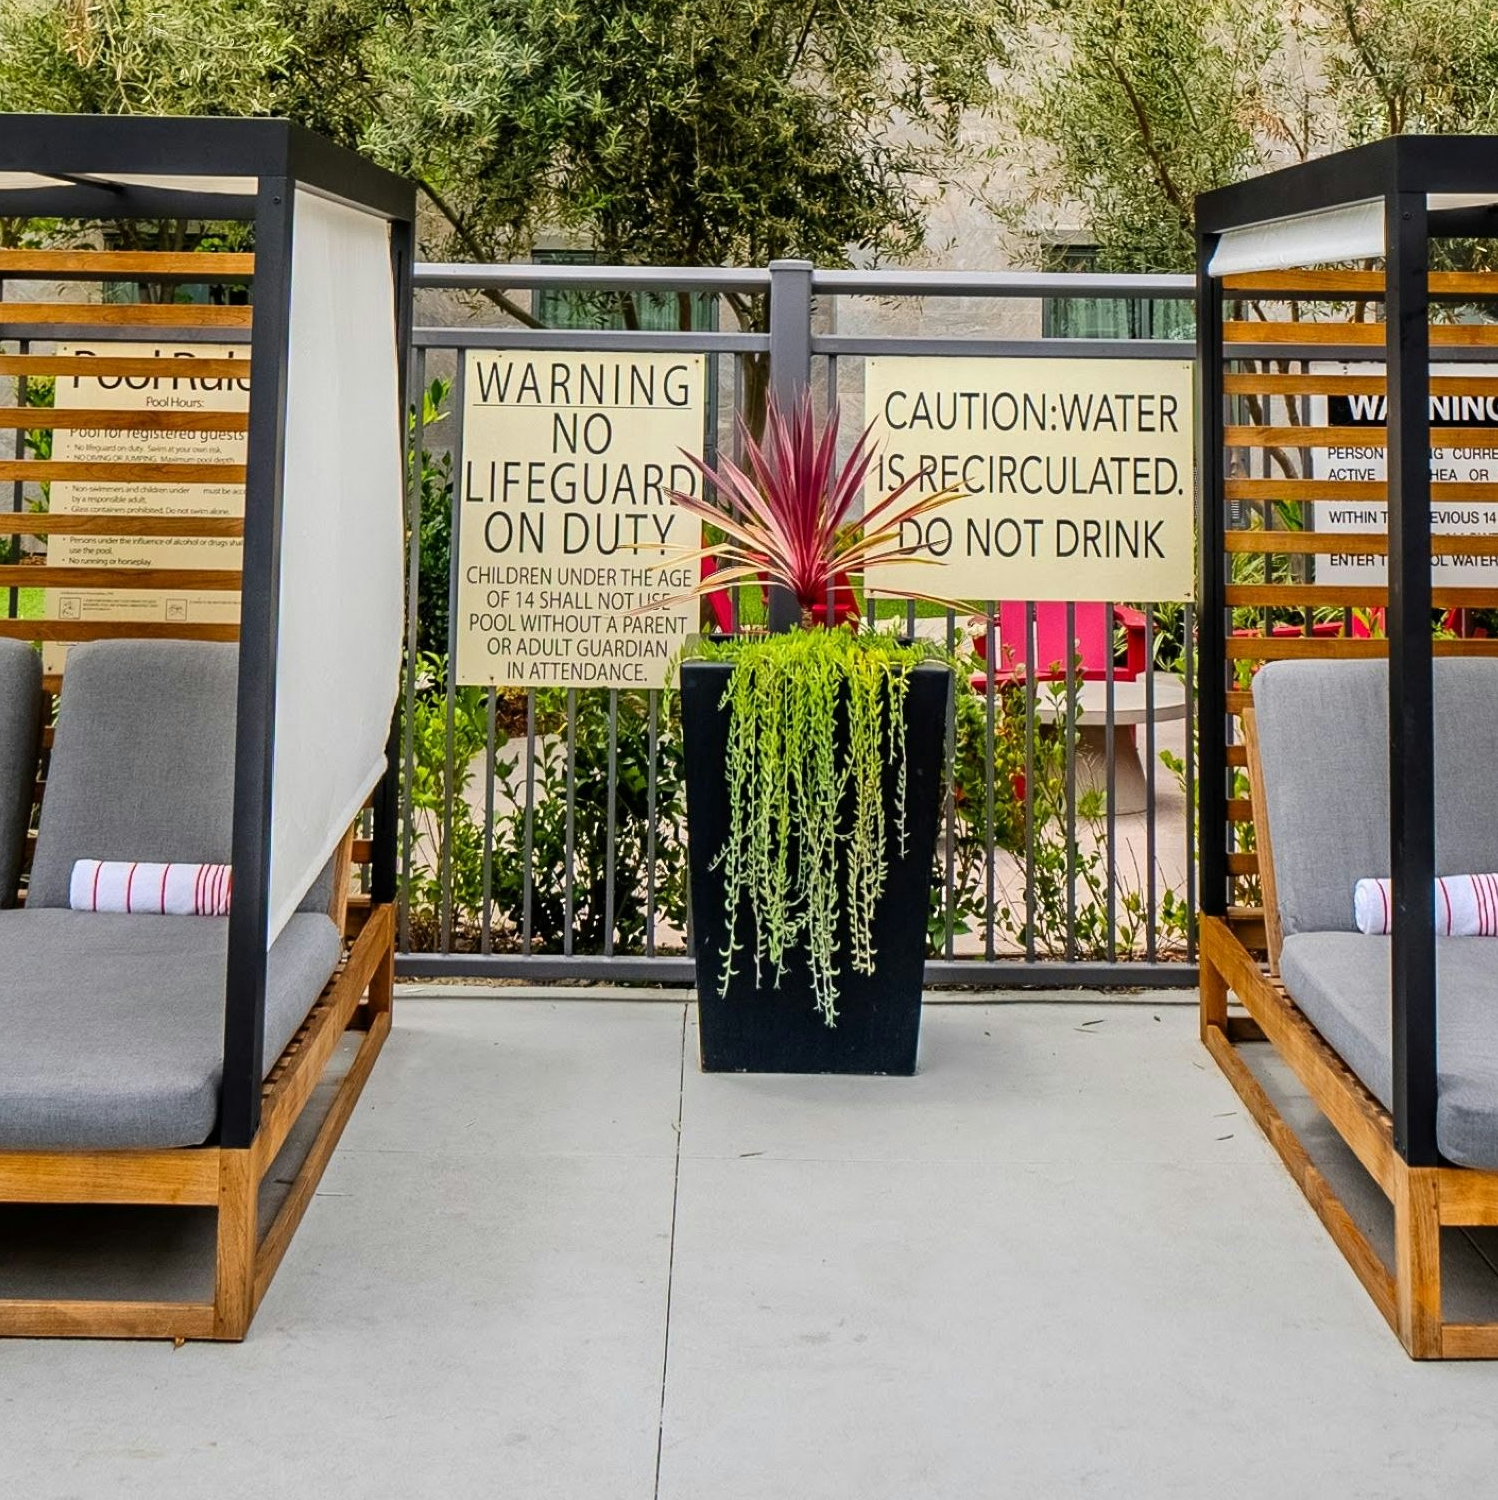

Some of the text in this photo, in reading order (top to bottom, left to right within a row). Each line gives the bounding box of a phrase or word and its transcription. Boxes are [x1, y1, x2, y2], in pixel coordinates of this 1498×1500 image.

[476, 361, 690, 407] WARNING
[146, 396, 204, 408] Pool Hours:
[70, 428, 100, 438] Pool
[127, 429, 196, 442] registered
[200, 430, 244, 443] guests
[552, 412, 613, 455] NO
[465, 460, 697, 506] LIFEGUARD
[878, 453, 1184, 496] IS RECIRCULATED.
[1329, 468, 1376, 481] ACTIVE
[1469, 469, 1489, 481] OR
[88, 496, 126, 504] responsible
[169, 486, 190, 494] under
[1328, 511, 1377, 524] WITHIN
[1430, 511, 1480, 524] EVIOUS
[1482, 511, 1496, 524] 14
[70, 536, 97, 544] Persons
[133, 537, 165, 545] influence
[208, 540, 229, 548] drugs
[484, 511, 676, 556] ON DUTY
[899, 517, 1166, 559] DO NOT DRINK
[81, 558, 108, 566] running
[1330, 554, 1375, 567] ENTER
[1452, 555, 1498, 567] WATER
[466, 565, 692, 588] CHILDREN UNDER THE AGE
[487, 590, 671, 611] OF 14 SHALL NOT USE
[469, 613, 688, 635] POOL WITHOUT A PARENT
[487, 636, 668, 658] OR ADULT GUARDIAN
[507, 661, 648, 682] IN ATTENDANCE.
